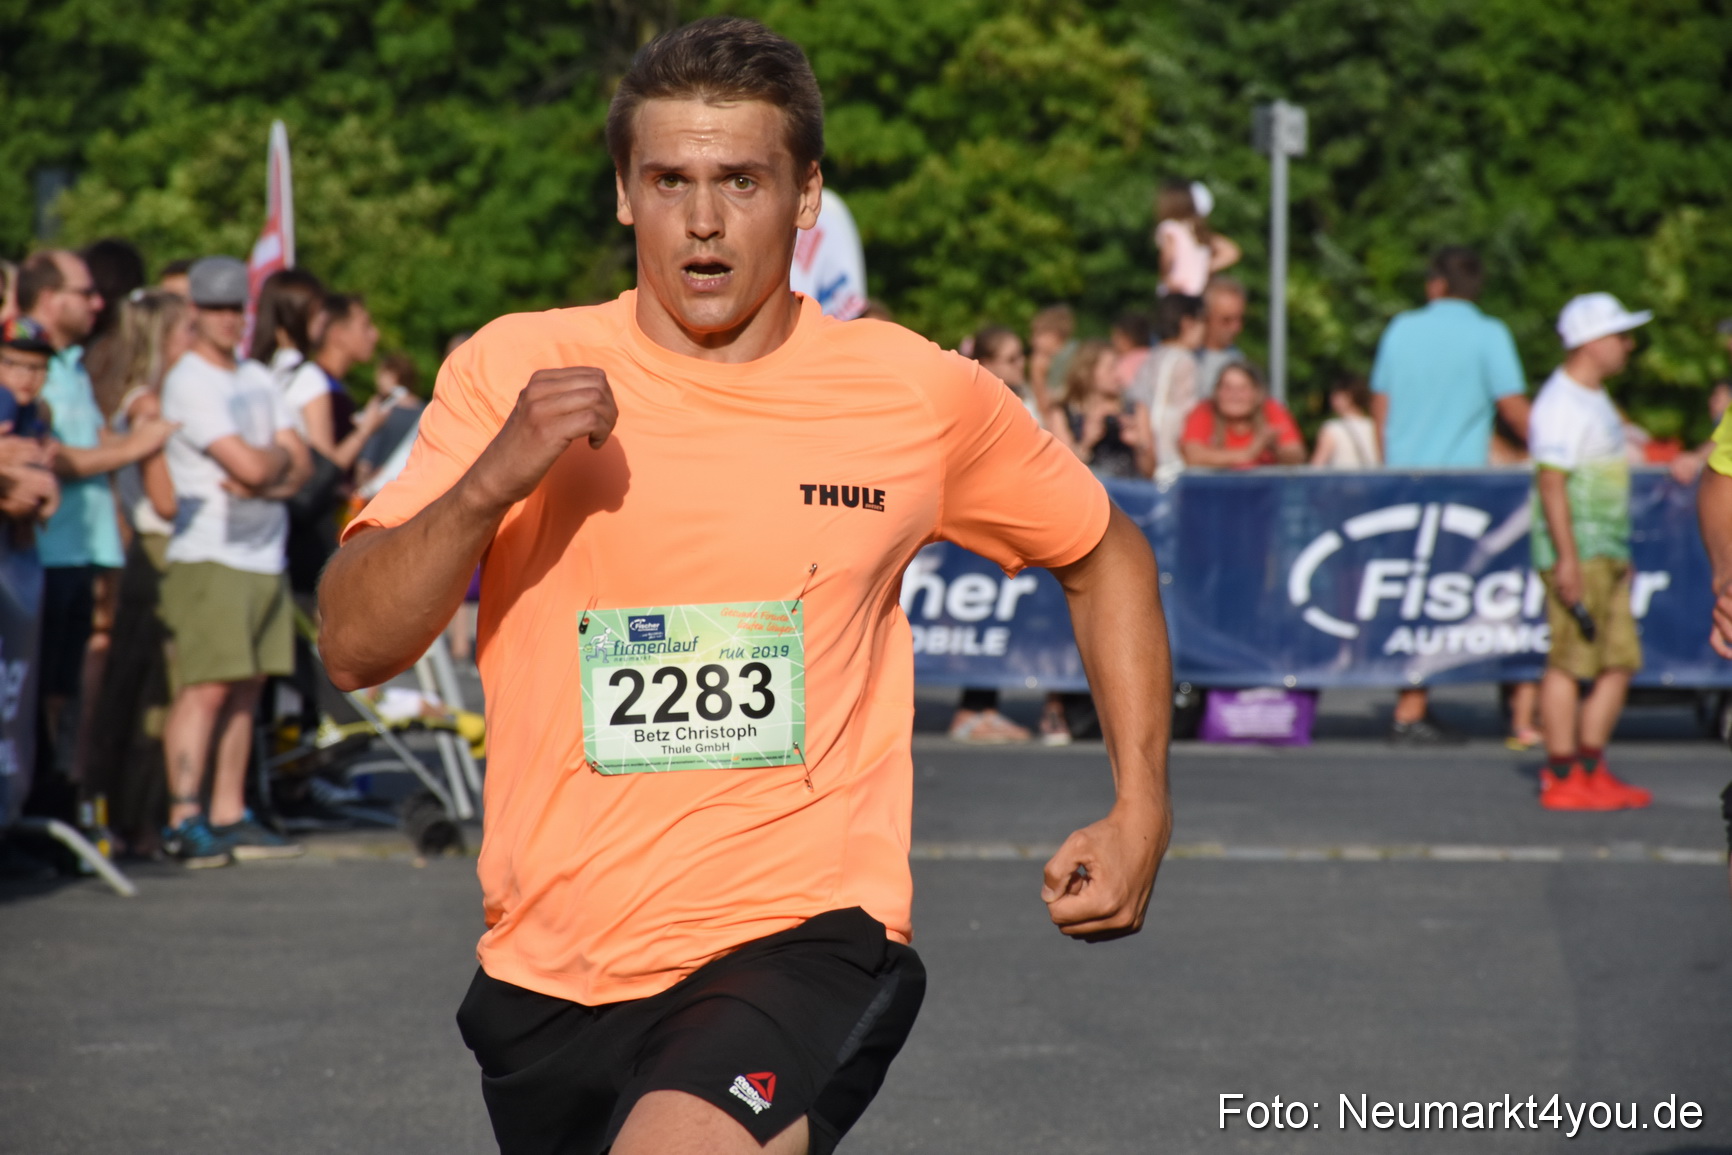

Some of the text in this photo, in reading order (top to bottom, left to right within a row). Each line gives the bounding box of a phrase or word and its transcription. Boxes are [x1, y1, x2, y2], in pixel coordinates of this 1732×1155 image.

[800, 484, 885, 511] THULE
[614, 636, 699, 656] firmenlauf
[752, 645, 789, 659] 2019
[609, 662, 775, 726] 2283
[634, 724, 757, 743] Betz Christoph
[661, 743, 730, 755] Thule GmbH
